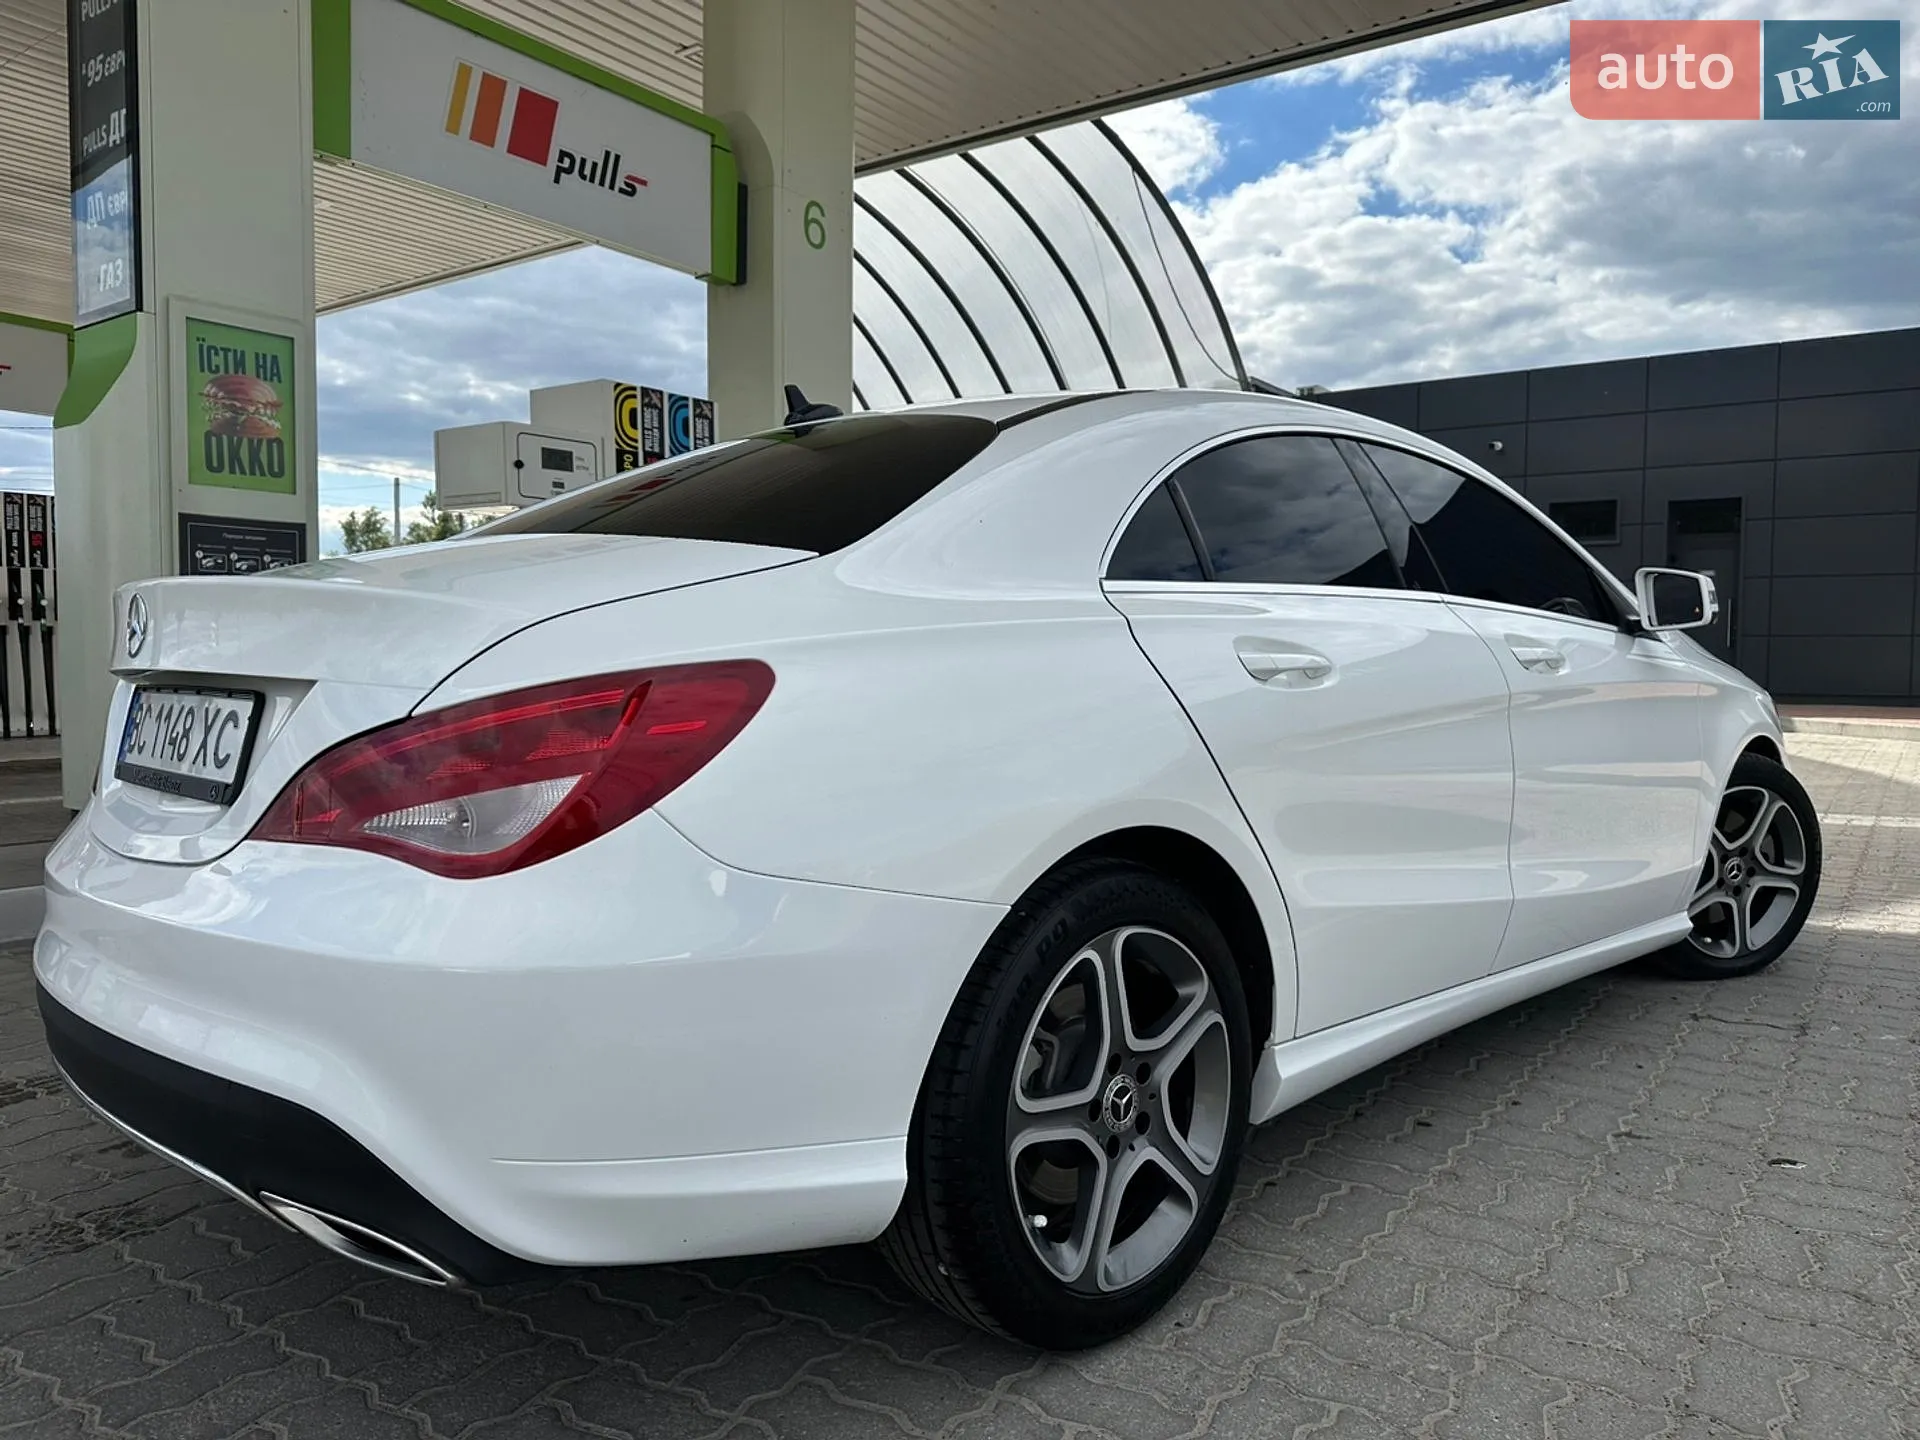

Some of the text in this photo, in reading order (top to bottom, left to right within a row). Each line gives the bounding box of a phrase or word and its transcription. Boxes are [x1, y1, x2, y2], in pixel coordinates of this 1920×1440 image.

[83, 124, 107, 157] PULLS
[553, 148, 648, 198] pulls
[87, 190, 127, 230] ДП ЄВР
[804, 200, 826, 250] 6
[100, 258, 122, 292] ГАЗ
[196, 336, 282, 383] ЇСТИ НА
[204, 429, 285, 479] ОККО
[151, 703, 195, 762] 1148
[192, 706, 239, 769] XC
